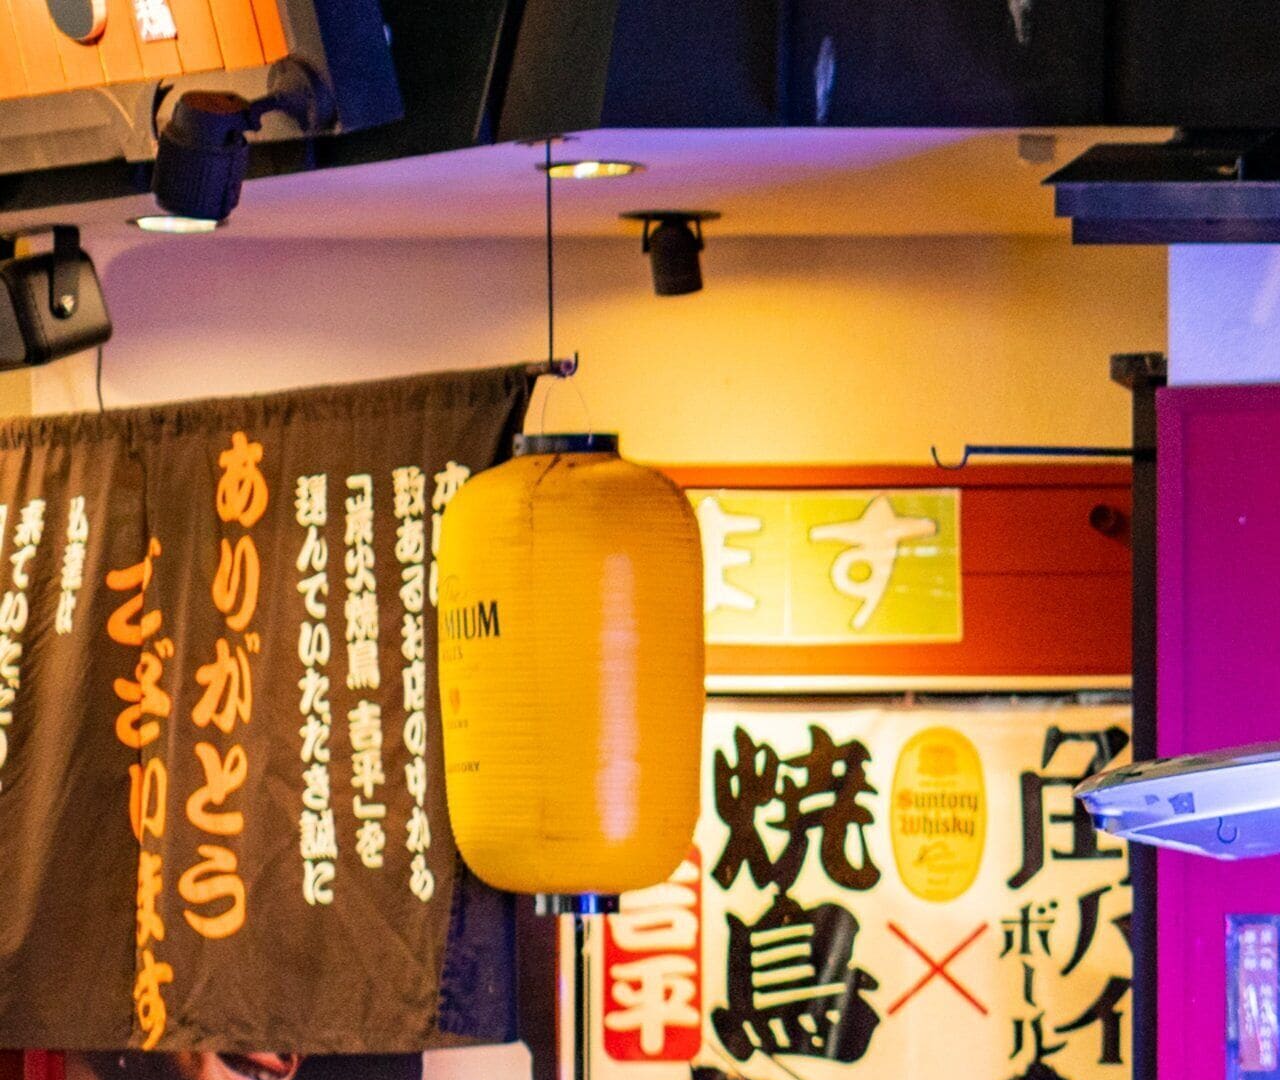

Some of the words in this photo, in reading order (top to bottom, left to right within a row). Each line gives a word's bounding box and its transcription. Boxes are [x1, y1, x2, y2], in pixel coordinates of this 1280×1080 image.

[105, 537, 174, 1052] ございます
[178, 430, 270, 939] ありがとう
[294, 473, 338, 907] 選んでいただき誠に
[391, 465, 436, 903] 数あるお店の中から
[898, 788, 980, 817] Suntory
[899, 815, 976, 841] Whisky
[711, 725, 881, 1063] 焼鳥
[1000, 901, 1067, 1060] ボール
